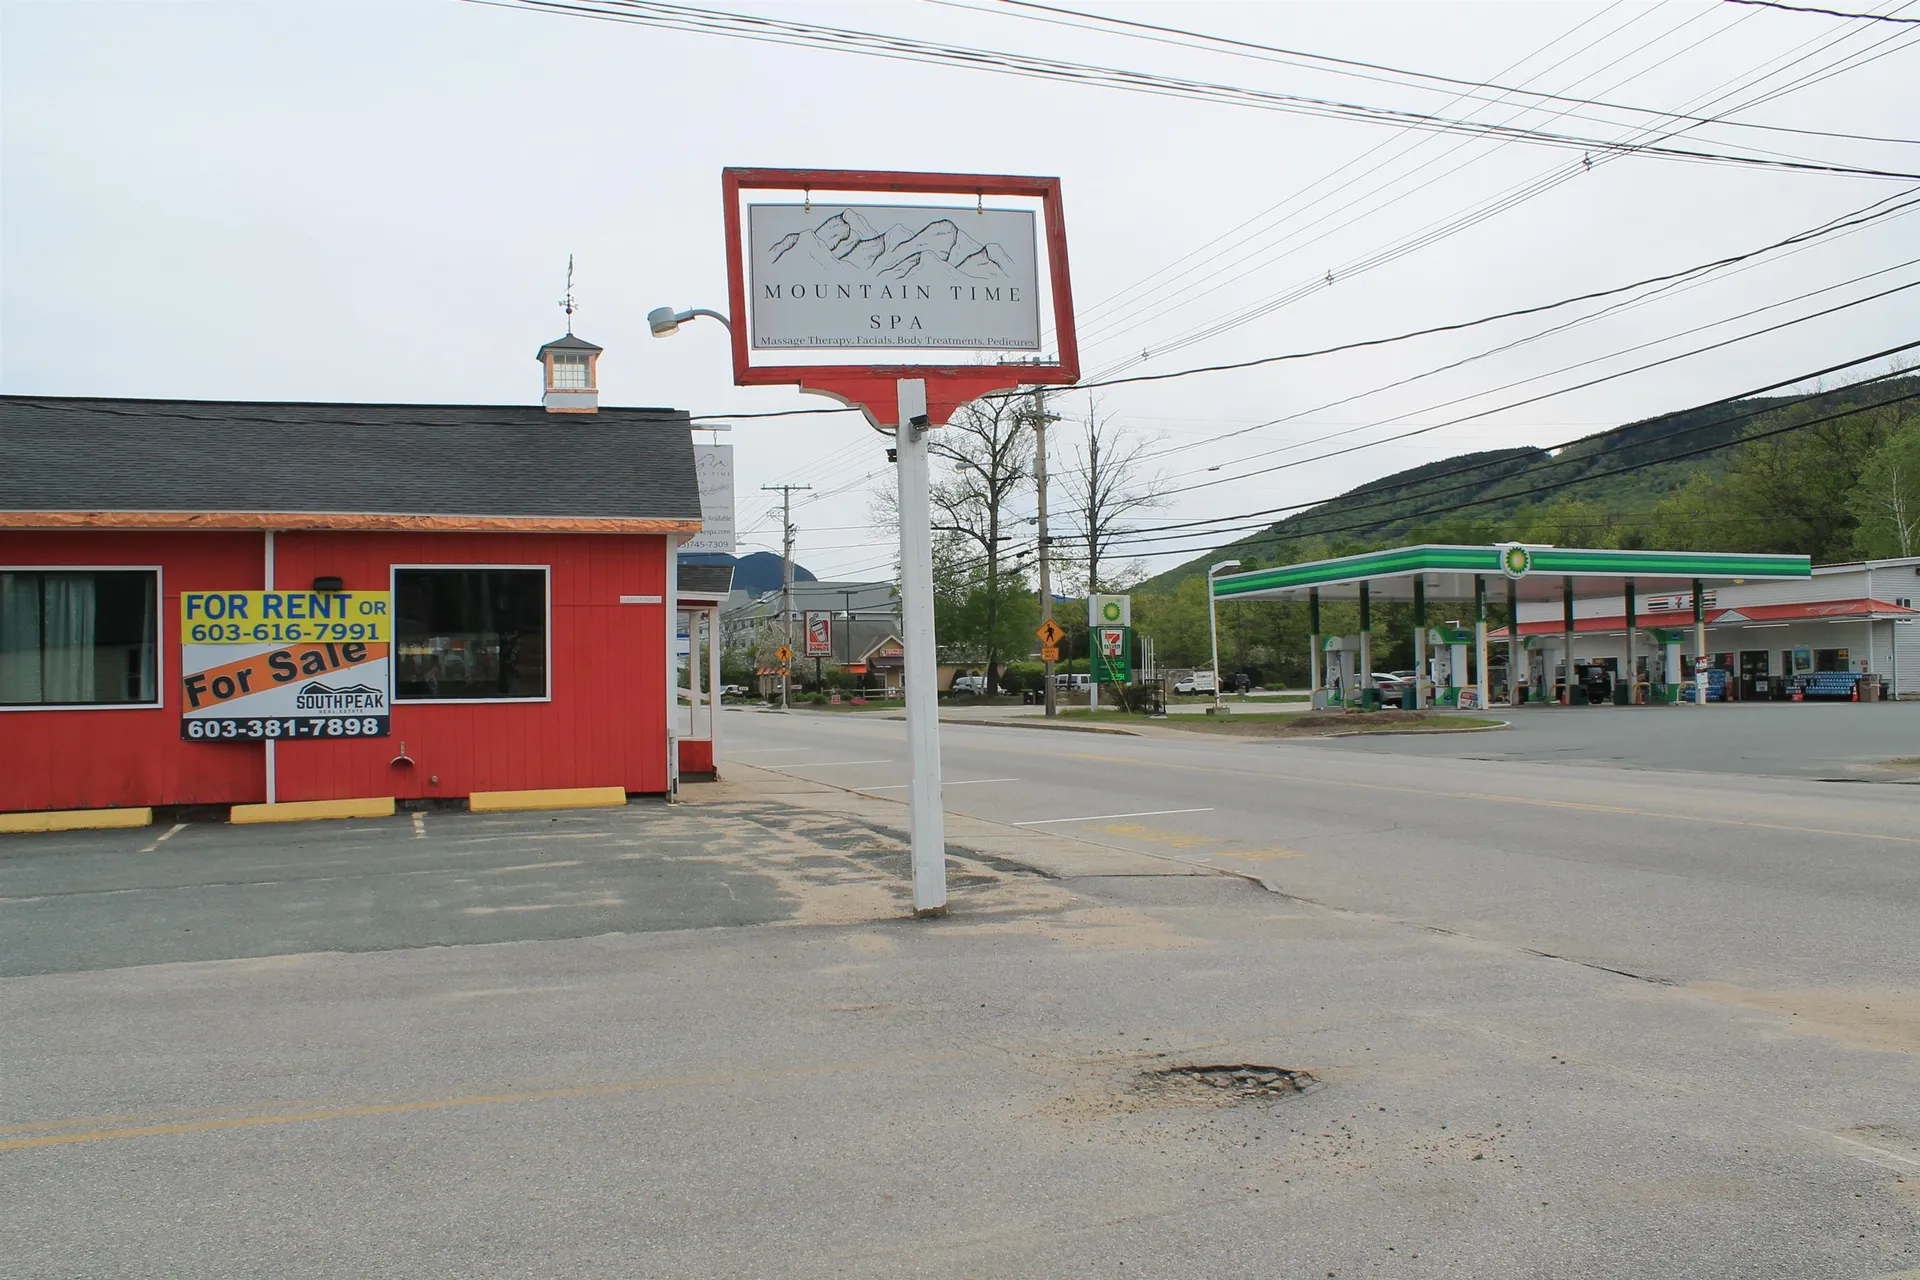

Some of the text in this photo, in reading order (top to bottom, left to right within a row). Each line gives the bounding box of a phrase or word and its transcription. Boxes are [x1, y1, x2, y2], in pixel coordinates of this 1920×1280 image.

[764, 284, 1021, 302] MOUNTAIN TIME
[870, 315, 924, 331] SPA
[761, 336, 806, 347] Massage
[897, 335, 923, 347] Body
[987, 337, 1035, 348] Pedicures
[708, 514, 732, 522] Available
[187, 593, 386, 620] FOR RENT OR
[191, 623, 380, 642] 603-616-7991
[184, 642, 368, 708] For Sale
[188, 717, 379, 738] 603-381-7898
